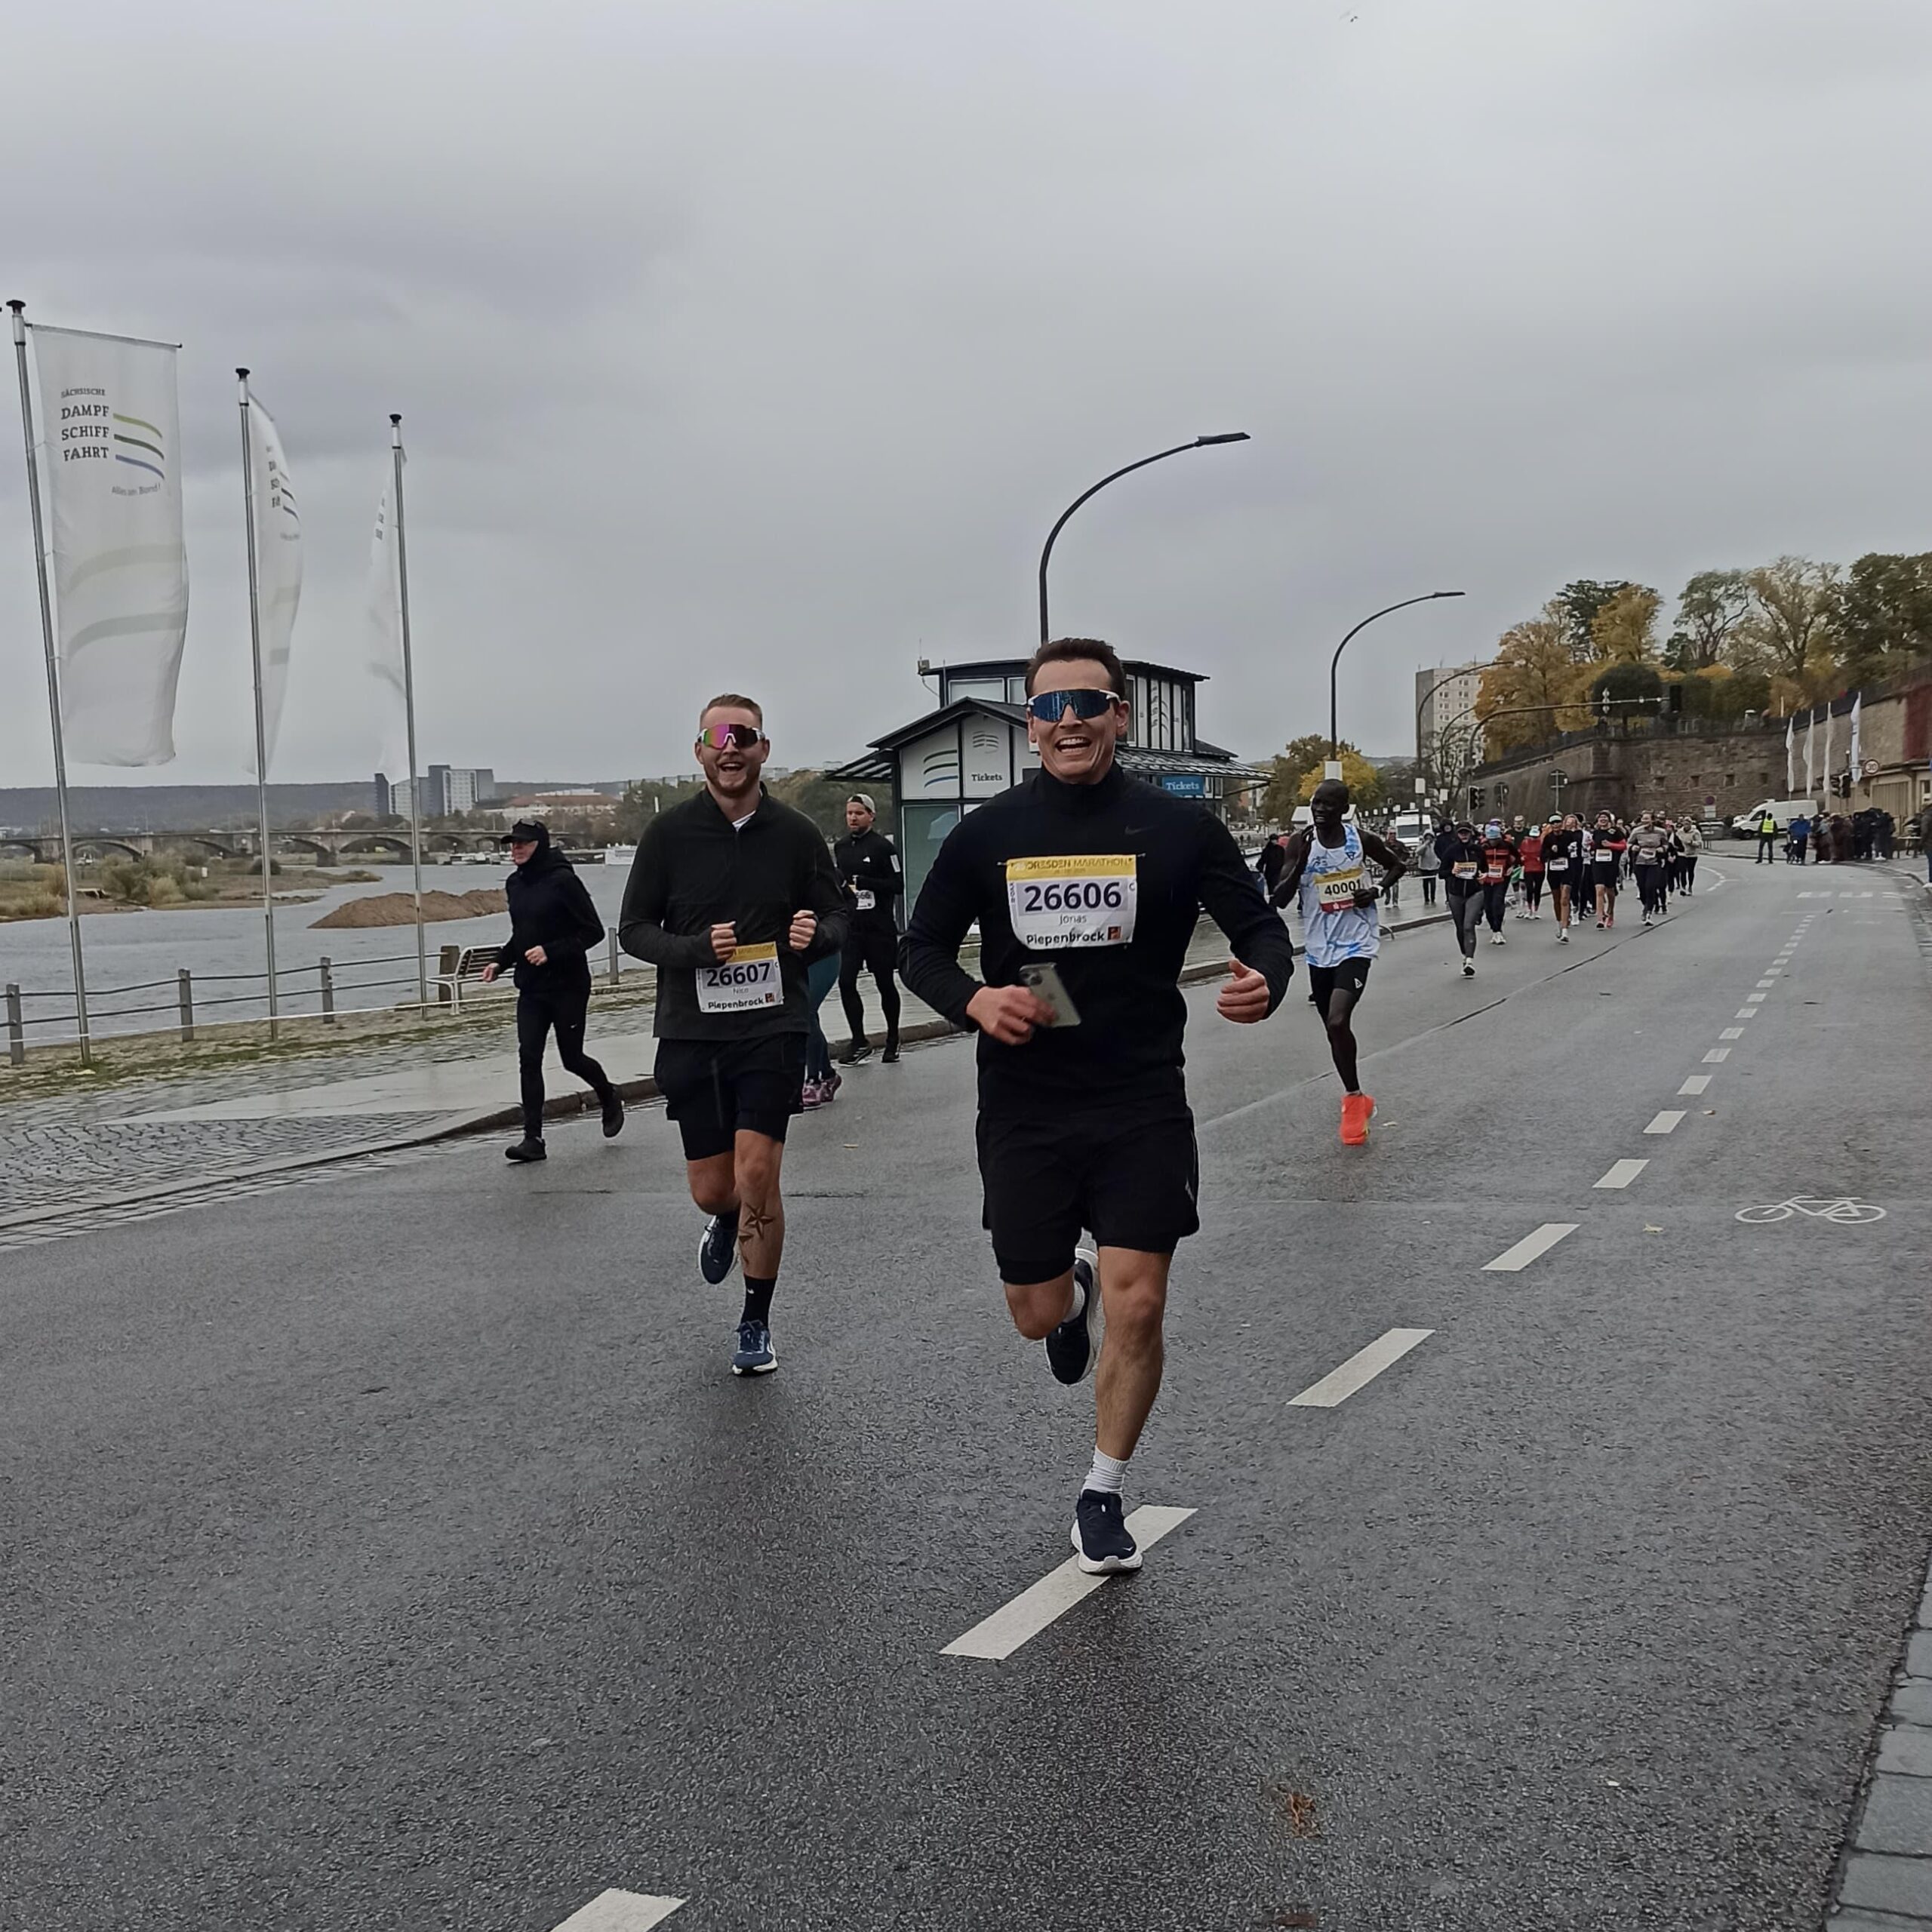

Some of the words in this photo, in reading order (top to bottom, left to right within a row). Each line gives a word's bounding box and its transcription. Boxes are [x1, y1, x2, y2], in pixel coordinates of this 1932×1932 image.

[61, 405, 109, 420] DAMPF
[62, 426, 109, 441] SCHIFF
[63, 447, 109, 462] FAHRT
[971, 774, 1002, 782] Tickets
[1166, 782, 1199, 790] Tickets
[1324, 878, 1361, 896] 40001
[1024, 882, 1121, 912] 26606
[1060, 915, 1087, 925] Jonas
[1026, 930, 1105, 946] Piepenbrock
[706, 962, 771, 987] 26607
[708, 998, 764, 1010] Piepenbrock
